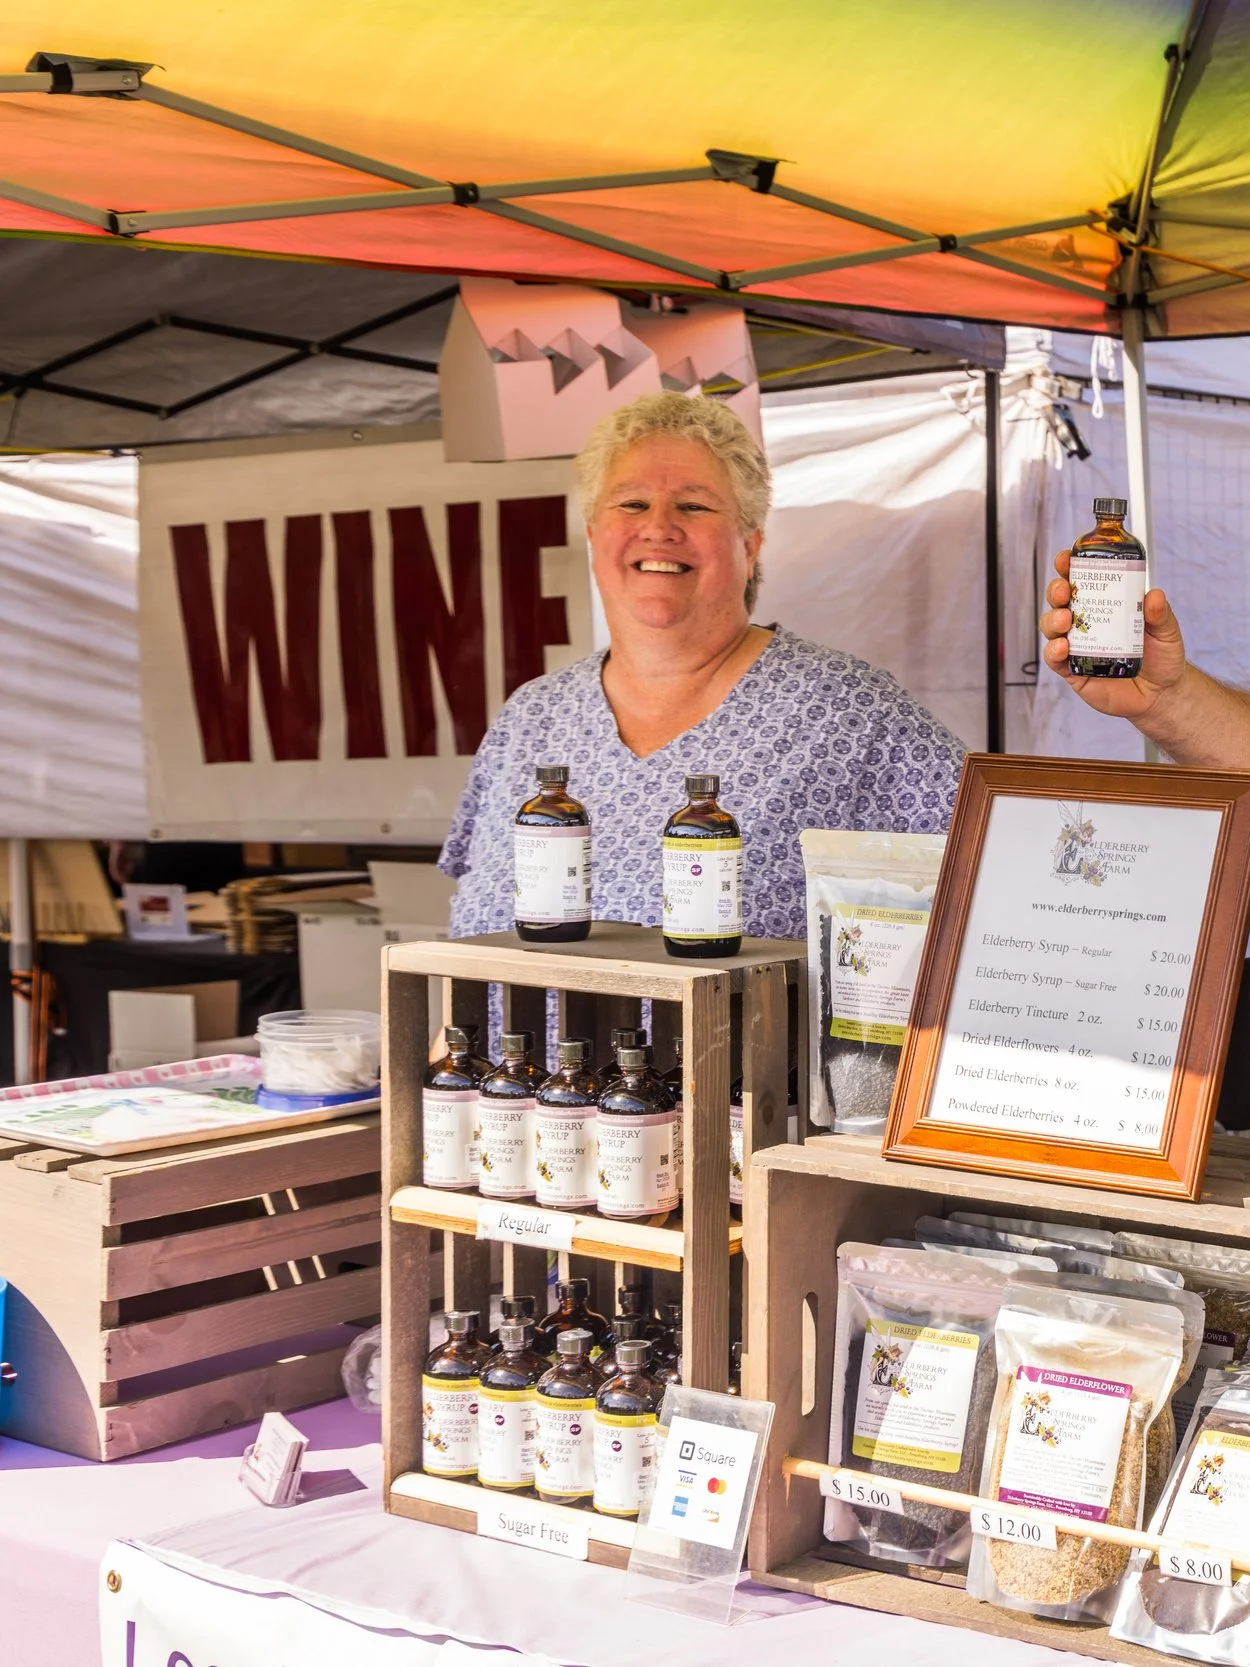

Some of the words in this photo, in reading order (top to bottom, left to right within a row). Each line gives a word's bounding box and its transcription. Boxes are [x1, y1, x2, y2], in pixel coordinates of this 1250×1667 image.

[1080, 582, 1108, 591] SYRUP
[168, 494, 571, 764] WINE
[1087, 614, 1110, 624] FARM
[1097, 851, 1136, 862] SPRINGS
[1102, 862, 1130, 874] FARM
[857, 909, 876, 917] DRIED
[878, 911, 923, 921] ELDERBERRIES
[1032, 903, 1166, 922] www.elderberrysprings.com
[982, 934, 1035, 951] Elderberry
[1039, 940, 1069, 955] Syrup
[1081, 946, 1112, 958] Regular
[1150, 950, 1157, 962] $
[1160, 951, 1191, 966] 20.00
[868, 958, 888, 967] FARM
[976, 966, 1029, 984] Elderberry
[1032, 972, 1062, 988] Syrup
[1075, 979, 1097, 991] Sugar
[1099, 982, 1117, 992] Free
[1144, 984, 1151, 996] $
[1153, 986, 1184, 999] 20.00
[968, 999, 1022, 1017] Elderberry
[1026, 1006, 1069, 1021] Tincture
[1078, 1011, 1084, 1022] 2
[1087, 1014, 1103, 1025] oz.
[1136, 1017, 1145, 1030] $
[1148, 1018, 1178, 1033] 15.00
[962, 1032, 990, 1045] Dried
[993, 1036, 1059, 1054] Elderflowers
[1068, 1045, 1076, 1055] 4
[1078, 1048, 1093, 1058] oz.
[1131, 1052, 1138, 1063] $
[1142, 1053, 1172, 1067] 12.00
[955, 1064, 983, 1079] Dried
[986, 1069, 1048, 1087] Elderberries
[1054, 1078, 1061, 1088] 8
[1065, 1081, 1079, 1091] oz.
[1124, 1086, 1131, 1097] $
[1136, 1087, 1165, 1100] 15.00
[948, 1098, 998, 1115] Powdered
[1002, 1104, 1064, 1123] Elderberries
[1073, 1114, 1080, 1125] 4
[1083, 1118, 1099, 1128] oz.
[1118, 1120, 1125, 1131] $
[1135, 1122, 1158, 1135] 8.00
[499, 1212, 551, 1235] Regular
[894, 1326, 917, 1336] DRIED
[918, 1329, 972, 1344] ELDERBERRIES
[904, 1370, 937, 1382] SPRINGS
[909, 1378, 933, 1391] FARM
[1044, 1373, 1068, 1384] DRIED
[1070, 1377, 1125, 1394] ELDERFLOWER
[1056, 1428, 1082, 1441] FARM
[697, 1447, 736, 1466] Square
[679, 1475, 694, 1484] VISA
[832, 1479, 841, 1496] $
[849, 1483, 890, 1507] 15.00
[499, 1513, 536, 1537] Sugar
[541, 1523, 568, 1543] Free
[981, 1513, 990, 1531] $
[999, 1517, 1041, 1541] 12.00
[1170, 1556, 1180, 1573] $
[1187, 1559, 1222, 1580] 8.00
